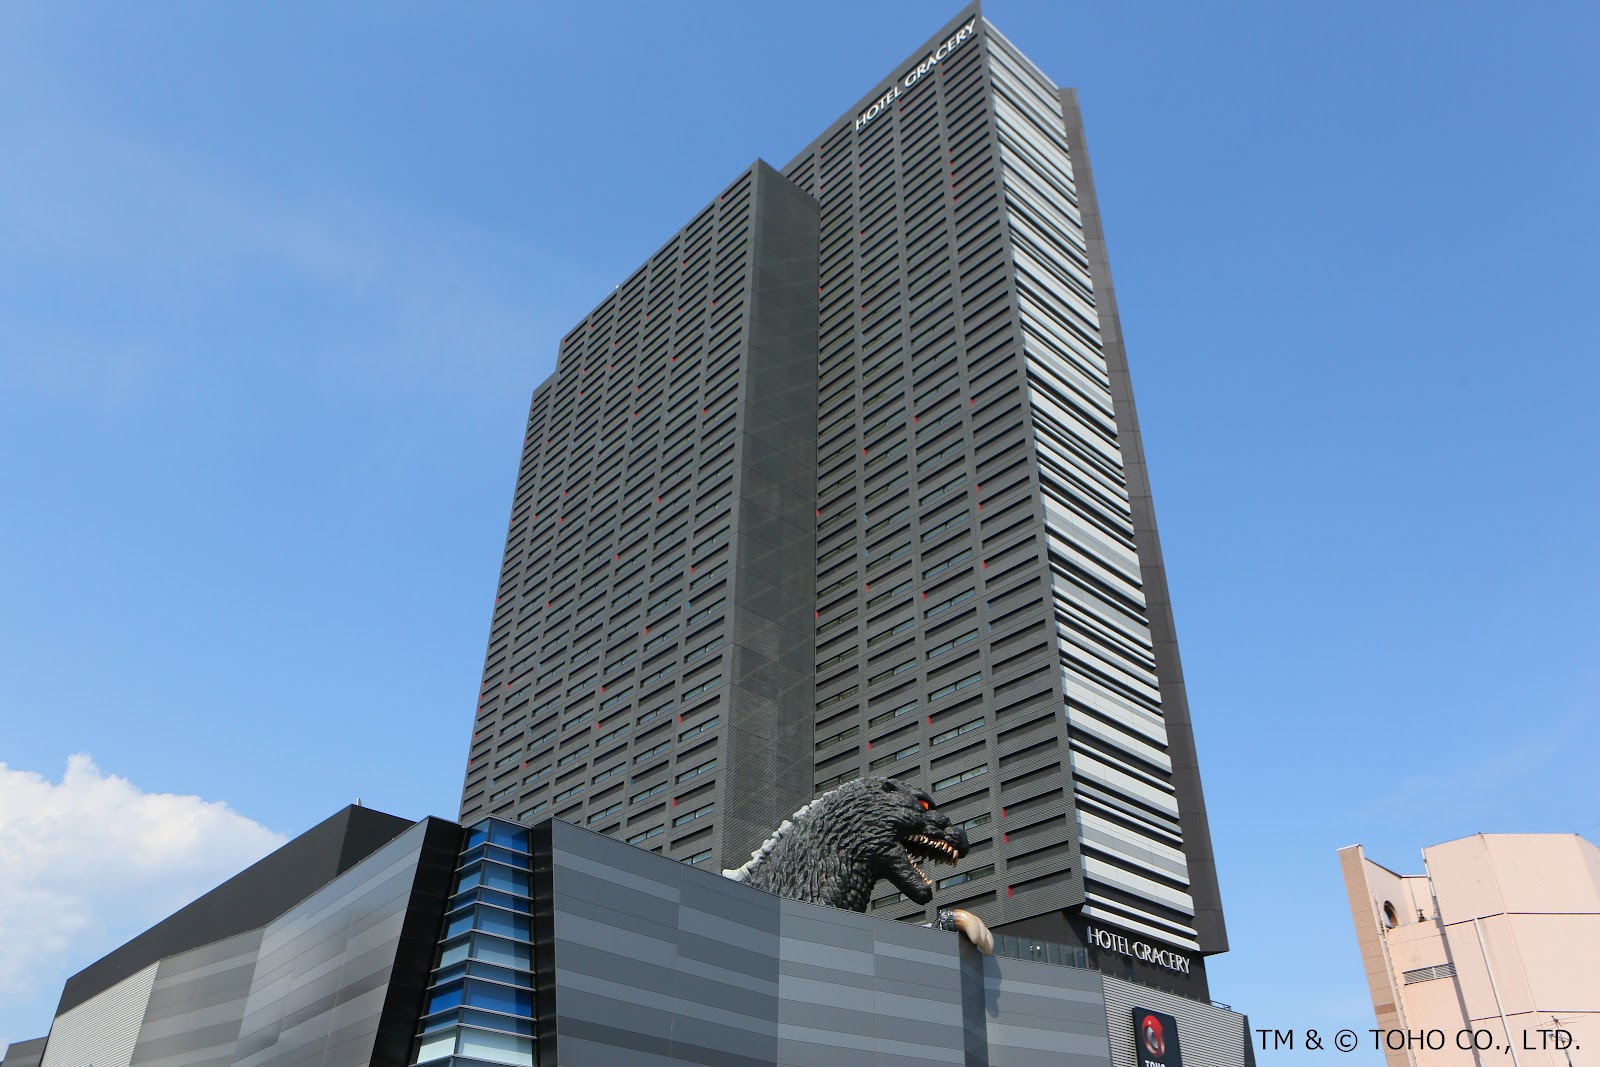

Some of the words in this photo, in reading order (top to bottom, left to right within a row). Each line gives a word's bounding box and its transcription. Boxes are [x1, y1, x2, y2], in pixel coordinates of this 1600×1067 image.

[855, 86, 902, 130] HOTEL
[904, 19, 976, 87] GRACERY
[1087, 926, 1133, 957] HOTEL
[1132, 941, 1190, 974] GRACERY
